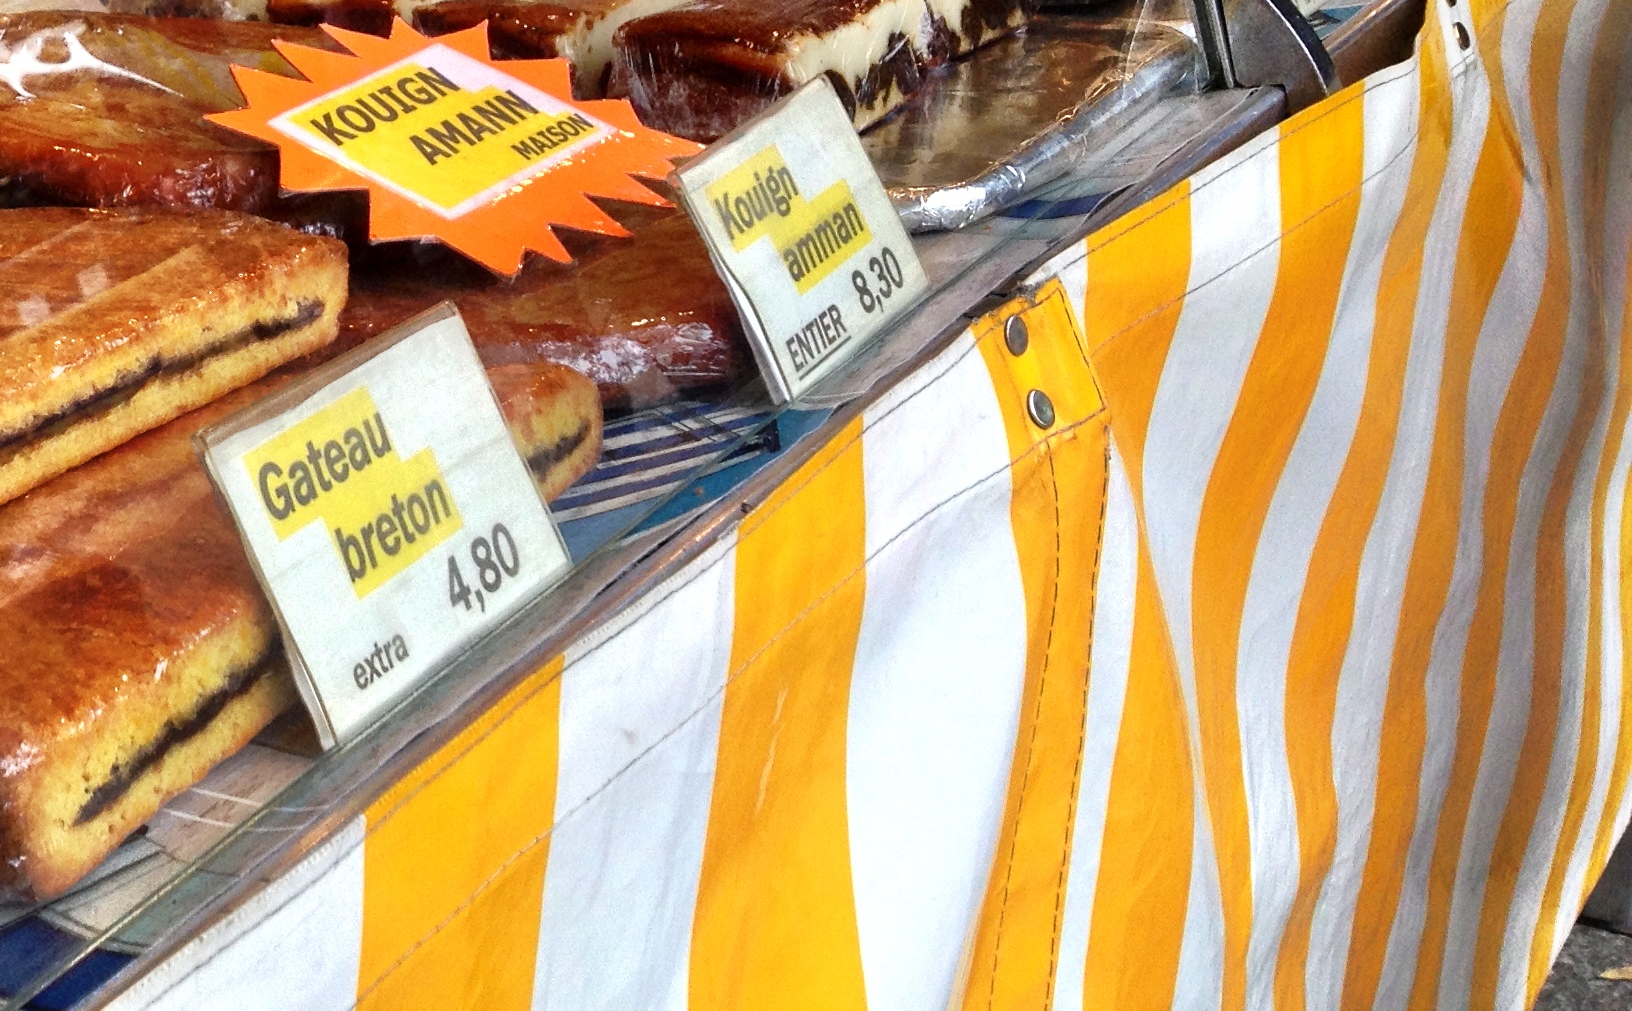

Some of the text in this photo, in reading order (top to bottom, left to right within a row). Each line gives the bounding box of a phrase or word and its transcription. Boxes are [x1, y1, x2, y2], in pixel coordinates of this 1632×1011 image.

[310, 65, 462, 149] KOUIGN
[406, 89, 539, 167] AMANN
[510, 111, 596, 162] MAISON
[713, 161, 799, 237] Kouign
[781, 201, 868, 284] amman
[850, 247, 906, 315] 8,30
[784, 303, 849, 372] ENTIER
[257, 411, 394, 521] Gateau
[334, 478, 453, 584] breton
[446, 522, 522, 614] 4,80
[352, 630, 410, 691] extra
